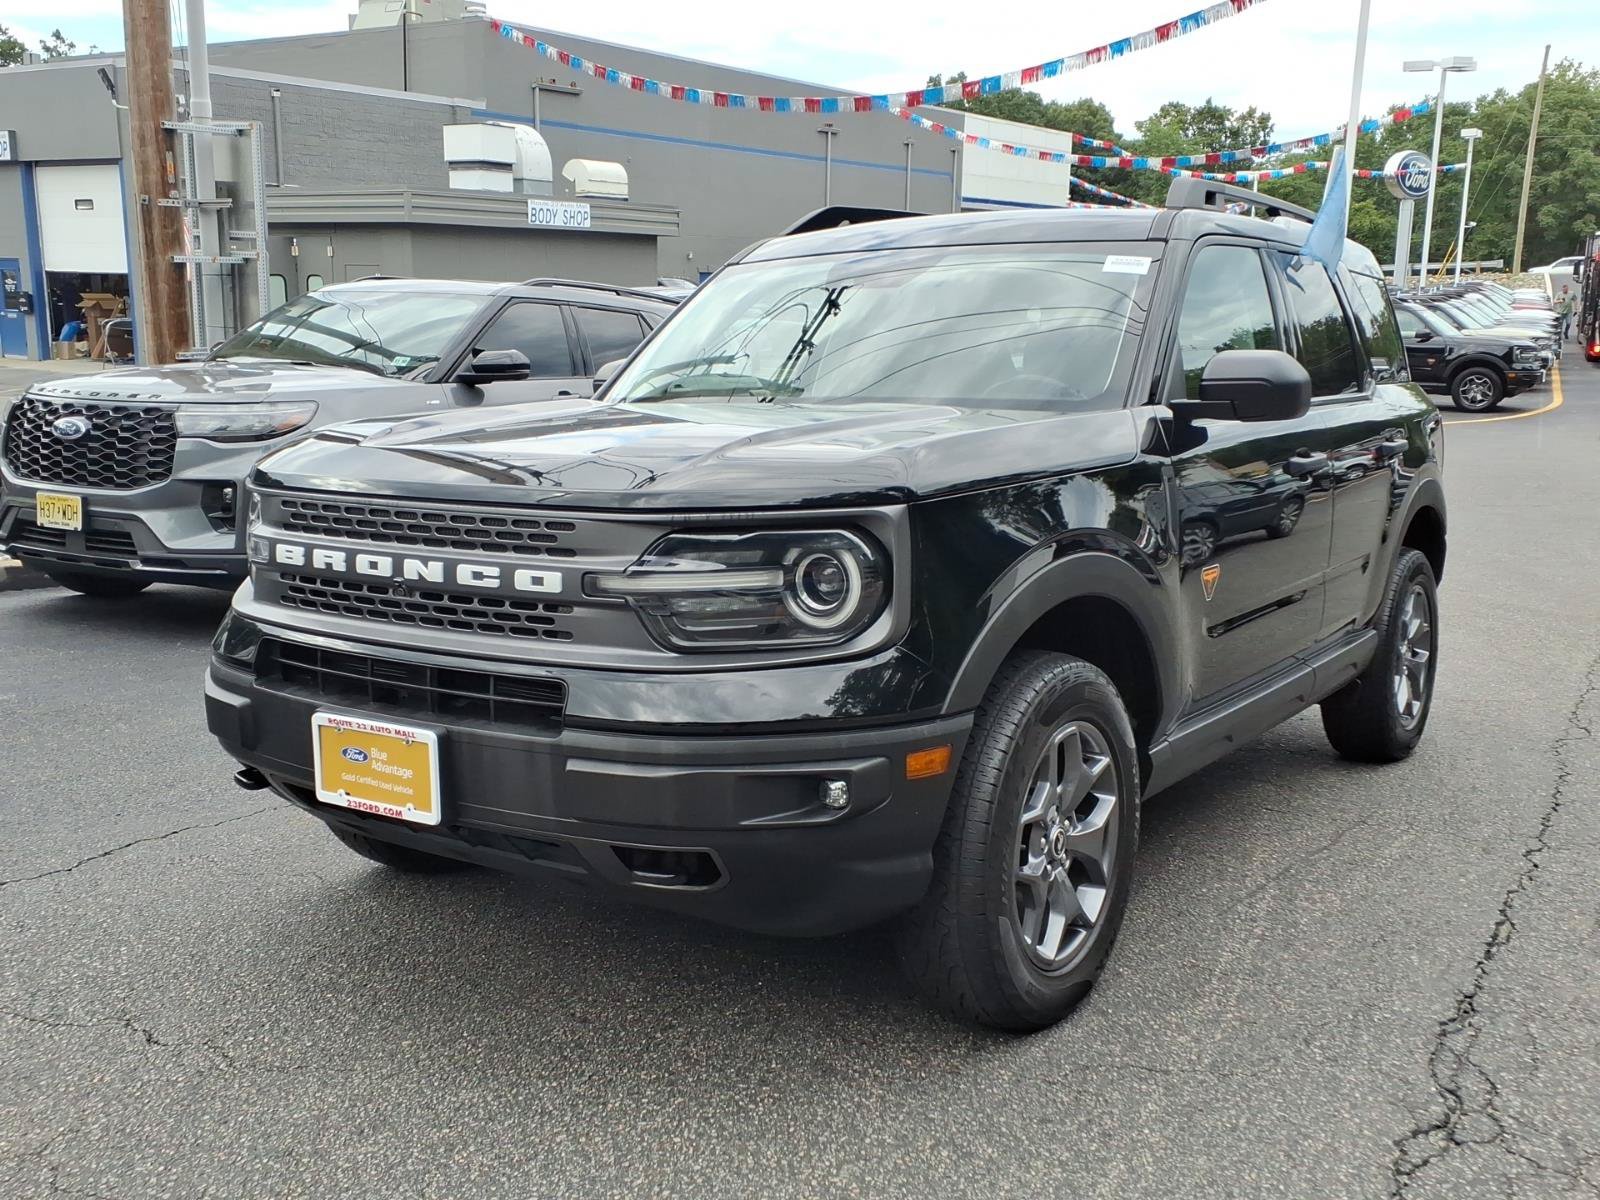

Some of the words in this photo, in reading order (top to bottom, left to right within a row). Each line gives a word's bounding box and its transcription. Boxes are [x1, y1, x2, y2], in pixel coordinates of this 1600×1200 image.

[1405, 160, 1431, 189] Ford
[530, 207, 558, 224] BODY
[562, 209, 589, 226] SHOP
[40, 501, 55, 519] H37
[275, 543, 563, 593] BRONCO
[327, 717, 353, 728] ROUTE
[356, 722, 368, 731] 23
[370, 725, 391, 735] AUTO
[395, 729, 416, 739] MALL
[344, 747, 366, 762] Ford
[370, 747, 388, 760] Blue
[371, 760, 413, 778] Advantage
[341, 772, 355, 782] Gold
[356, 775, 379, 788] Certified
[379, 780, 392, 791] Used
[393, 783, 414, 795] Vehicle
[346, 800, 403, 818] 23FORD.COM
